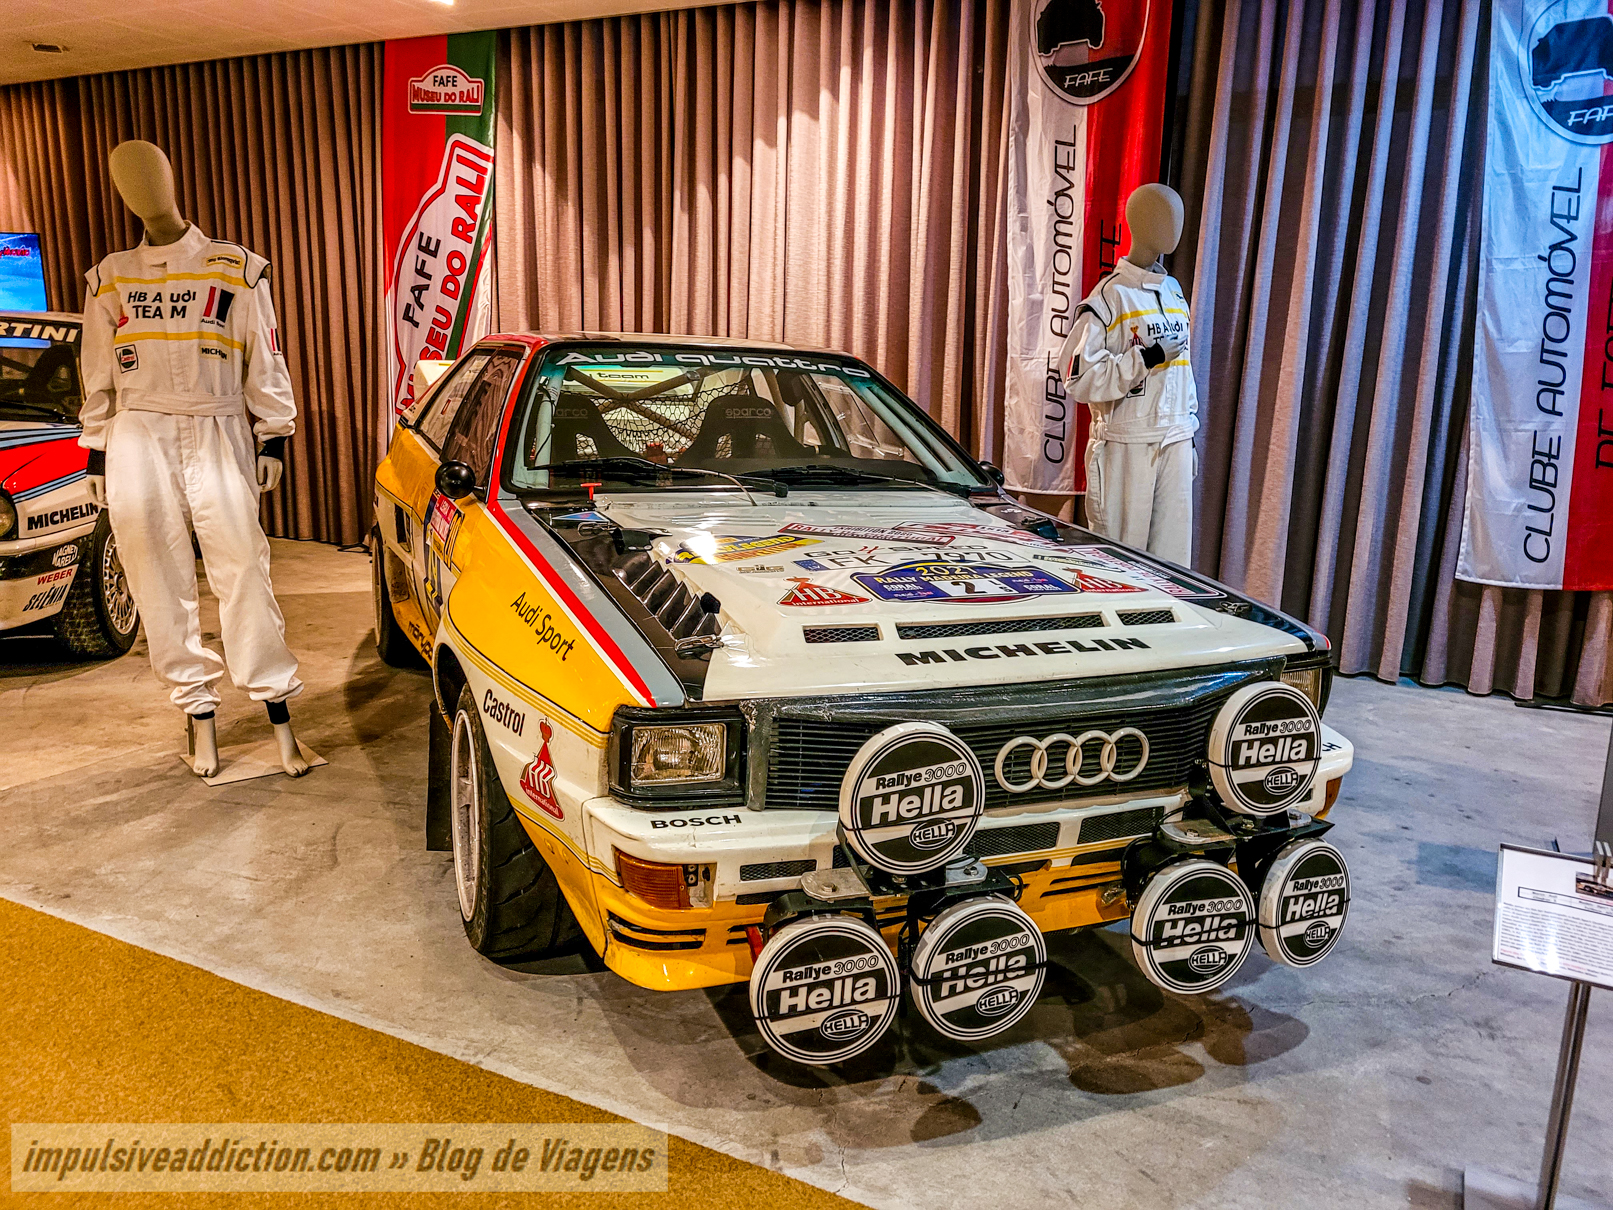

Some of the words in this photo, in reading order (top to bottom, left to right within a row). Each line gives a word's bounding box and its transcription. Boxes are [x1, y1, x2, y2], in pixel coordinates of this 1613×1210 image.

[433, 75, 458, 87] FAFE
[1063, 68, 1113, 88] FAFE
[412, 83, 442, 103] MUSEU
[444, 92, 457, 103] DO
[459, 84, 480, 103] RALI
[451, 154, 489, 244] RALI
[1047, 124, 1077, 339] AUTOMÓVEL
[402, 231, 441, 329] FAFE
[440, 250, 467, 301] DO
[127, 291, 148, 303] HB
[1536, 166, 1583, 417] AUTOMÓVEL
[1147, 322, 1161, 336] HB
[555, 351, 663, 366] Audi
[674, 352, 871, 378] quattro
[597, 372, 650, 380] team
[555, 408, 588, 417] arco
[725, 407, 773, 419] sparco
[1523, 429, 1561, 564] CLUBE
[27, 502, 98, 531] MICHELIN
[37, 568, 73, 586] WEBER
[874, 576, 918, 584] RALLY
[919, 573, 983, 582] MADEIRA
[984, 571, 1034, 579] LEGEND
[916, 566, 978, 576] 2021
[1075, 578, 1123, 589] HB
[791, 587, 842, 601] HB
[951, 581, 987, 595] 2
[510, 591, 544, 627] Audi
[534, 613, 576, 661] Sport
[894, 637, 1152, 666] MICHELIN
[482, 688, 526, 738] Castrol
[1244, 722, 1279, 736] Rallye
[1280, 719, 1312, 734] 3000
[1238, 736, 1308, 766] Hella
[528, 756, 556, 799] HB
[875, 772, 922, 791] Rallye
[924, 762, 967, 782] 3000
[870, 784, 964, 826] Hella
[650, 815, 742, 829] BOSCH
[1293, 878, 1319, 892] Rallye
[1320, 875, 1344, 889] 3000
[1167, 902, 1205, 916] Rallye
[1206, 899, 1244, 913] 3000
[1285, 892, 1340, 922] Hella
[1160, 916, 1238, 947] Hella
[945, 944, 989, 966] Rallye
[989, 933, 1031, 954] 3000
[782, 965, 832, 984] Rallye
[833, 955, 880, 975] 3000
[940, 954, 1027, 998] Hella
[779, 976, 877, 1015] Hella
